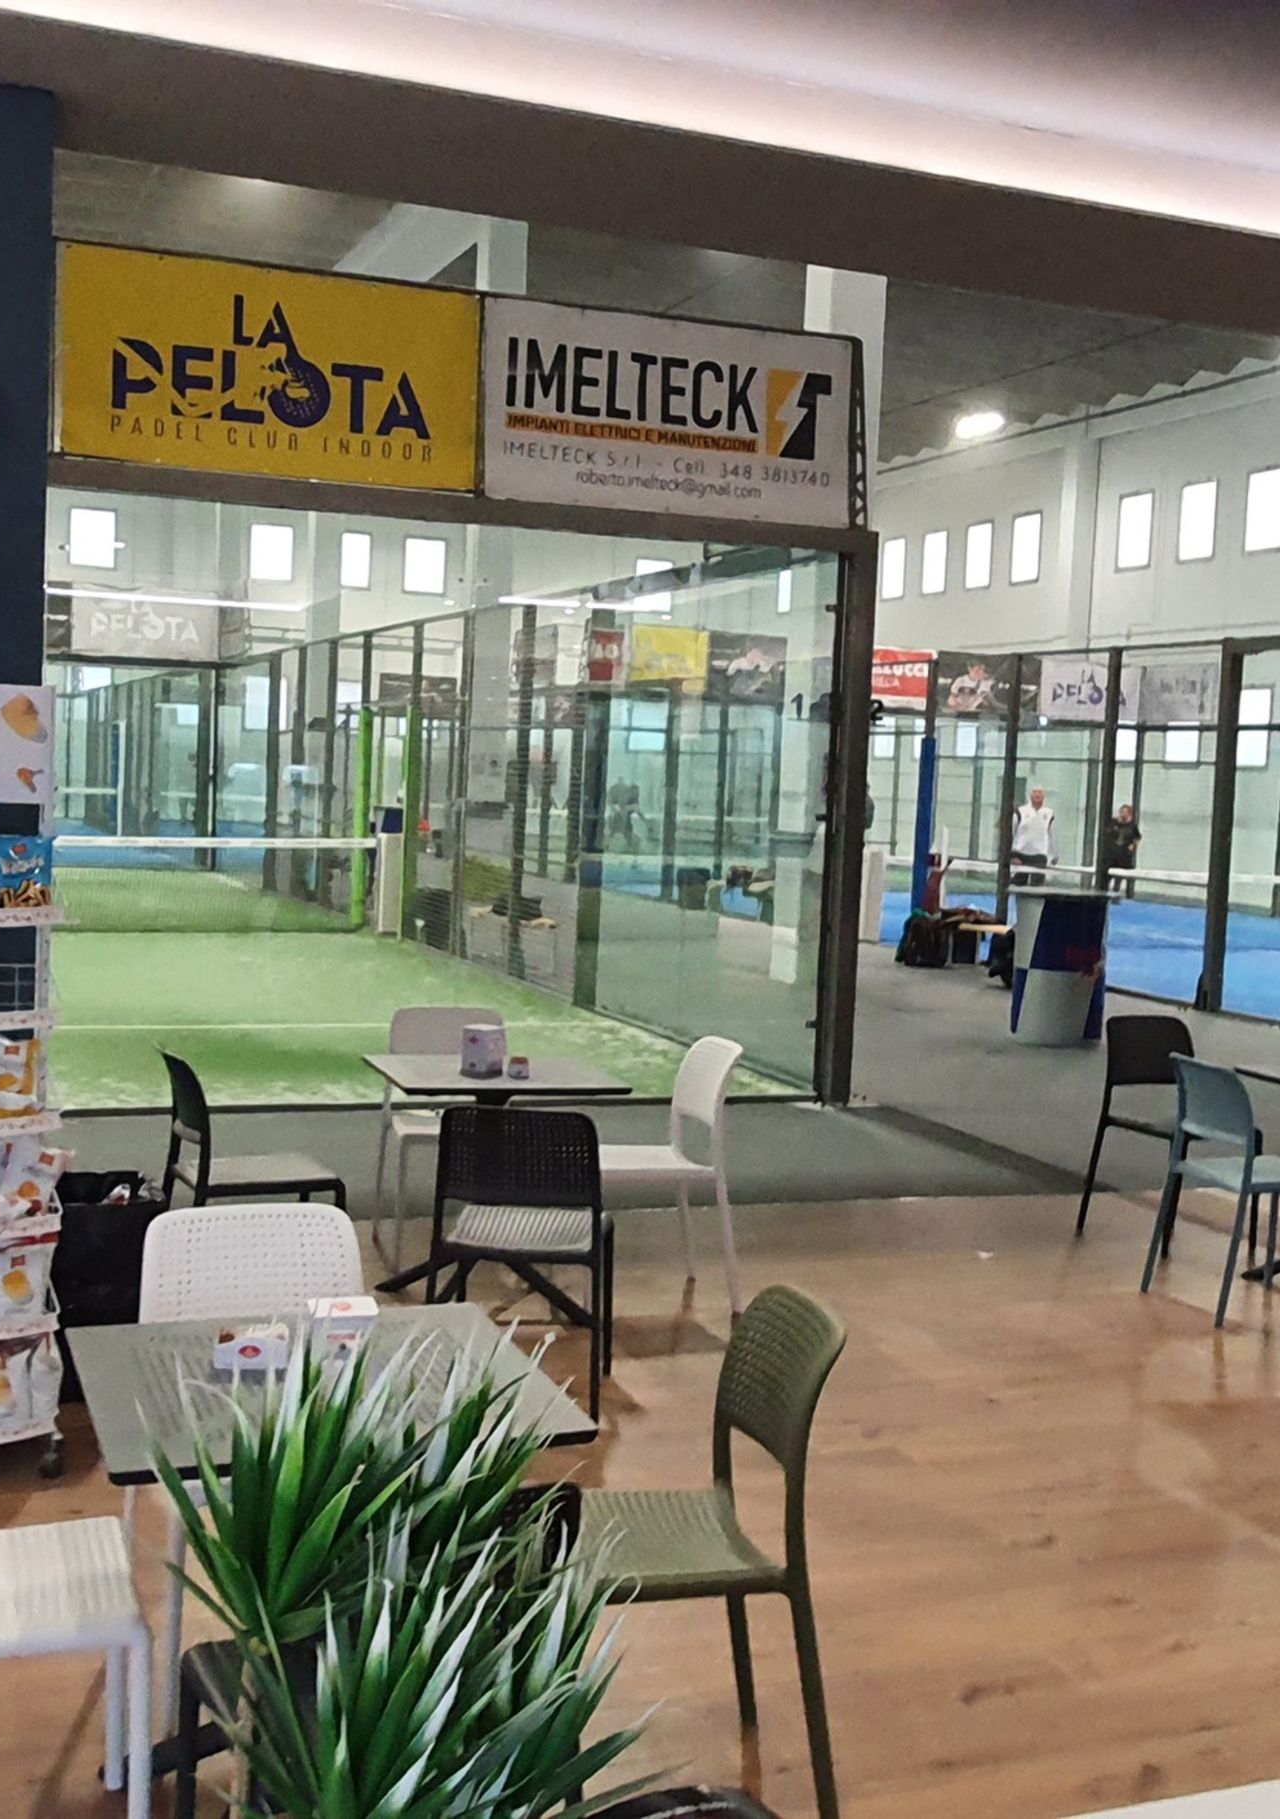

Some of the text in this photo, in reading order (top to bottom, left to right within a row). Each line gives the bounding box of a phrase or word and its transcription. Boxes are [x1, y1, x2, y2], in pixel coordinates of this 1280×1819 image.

[232, 293, 298, 350] LA
[111, 335, 432, 440] PELOTA
[506, 336, 760, 434] IMELTECK
[110, 413, 204, 442] PADEL
[323, 435, 432, 464] INDOOR
[507, 414, 757, 453] IMPIANTI ELETTRICI E MANUTENZIONI
[503, 440, 597, 465] IMELTECK
[720, 461, 753, 481] 348
[760, 465, 830, 488] 3813740
